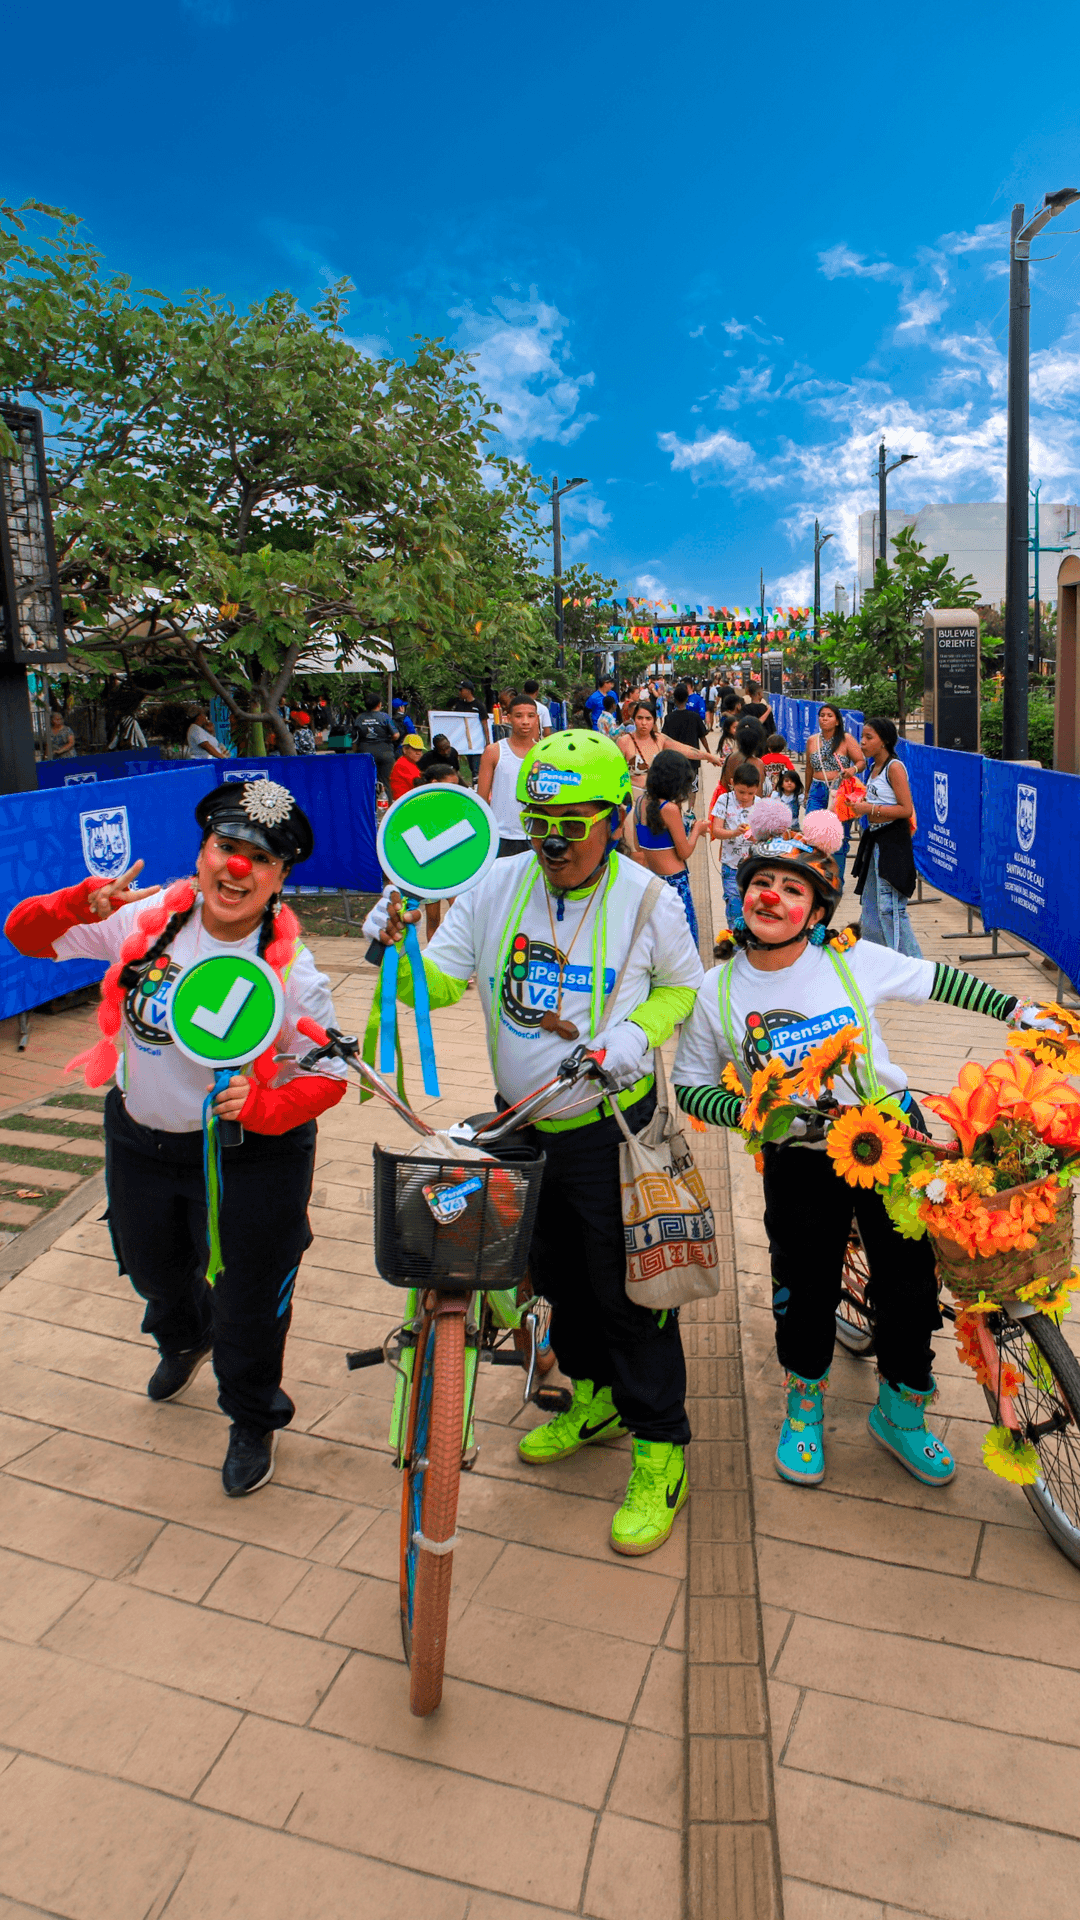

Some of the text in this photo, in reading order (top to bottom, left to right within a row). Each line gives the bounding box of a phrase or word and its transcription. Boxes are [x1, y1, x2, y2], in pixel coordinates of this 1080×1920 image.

[938, 629, 975, 638] BULEVAR
[938, 639, 976, 648] ORIENTE
[1006, 862, 1045, 888] SANTIAGO DE CALI
[529, 966, 610, 989] ¡Pensal,
